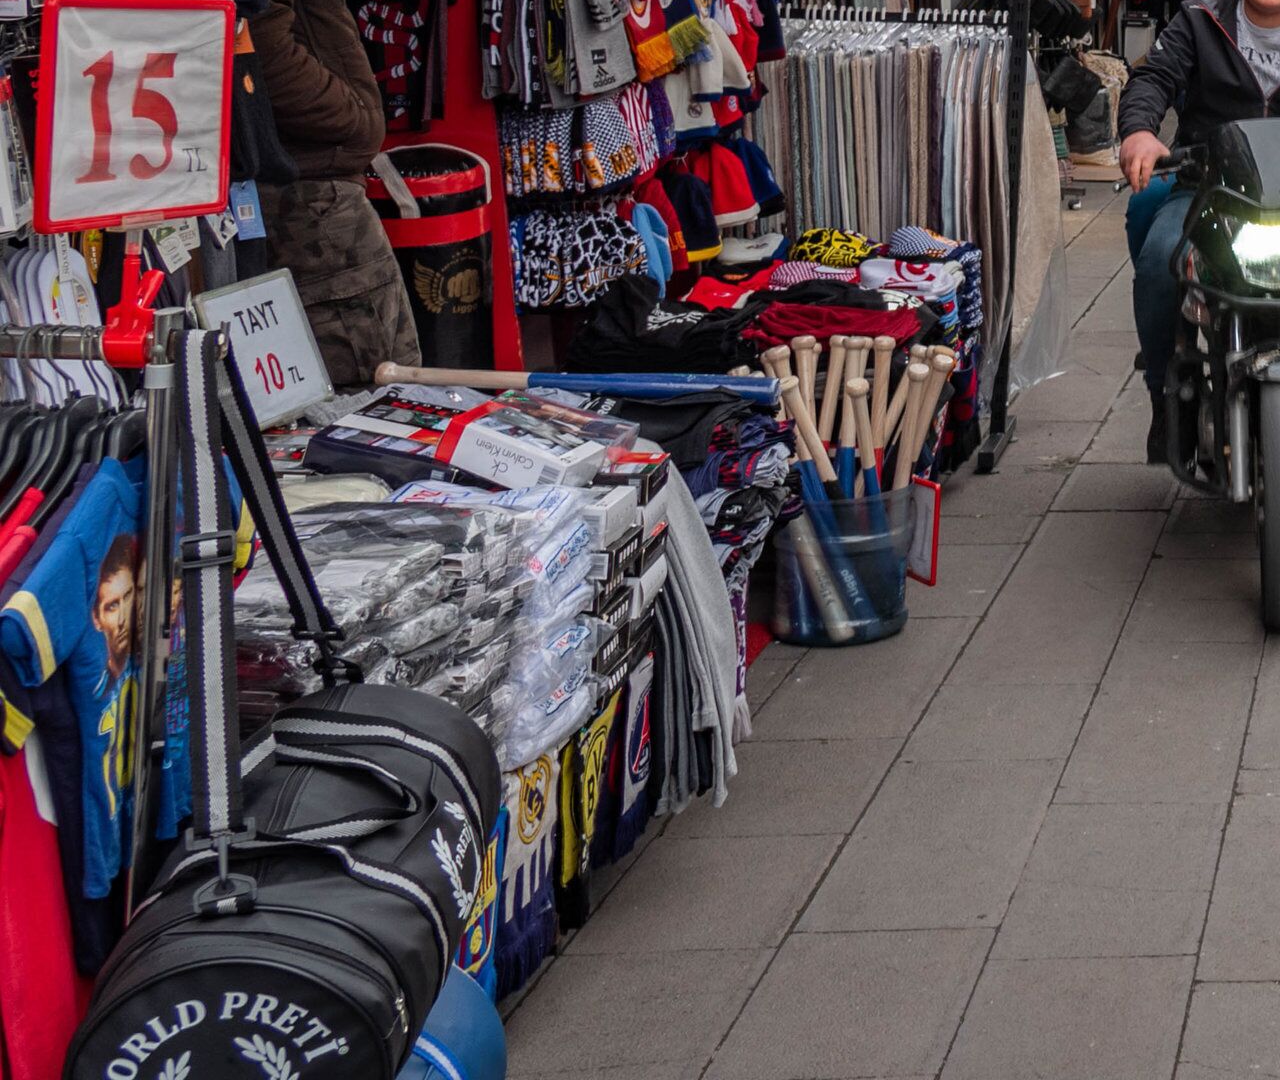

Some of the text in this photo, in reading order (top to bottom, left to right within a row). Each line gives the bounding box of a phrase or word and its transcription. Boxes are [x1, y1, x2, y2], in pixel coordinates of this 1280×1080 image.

[74, 50, 179, 185] 15
[182, 147, 208, 173] TL
[233, 299, 281, 336] TAYT
[254, 351, 305, 395] 10 TL
[476, 438, 534, 470] Calvin Klein
